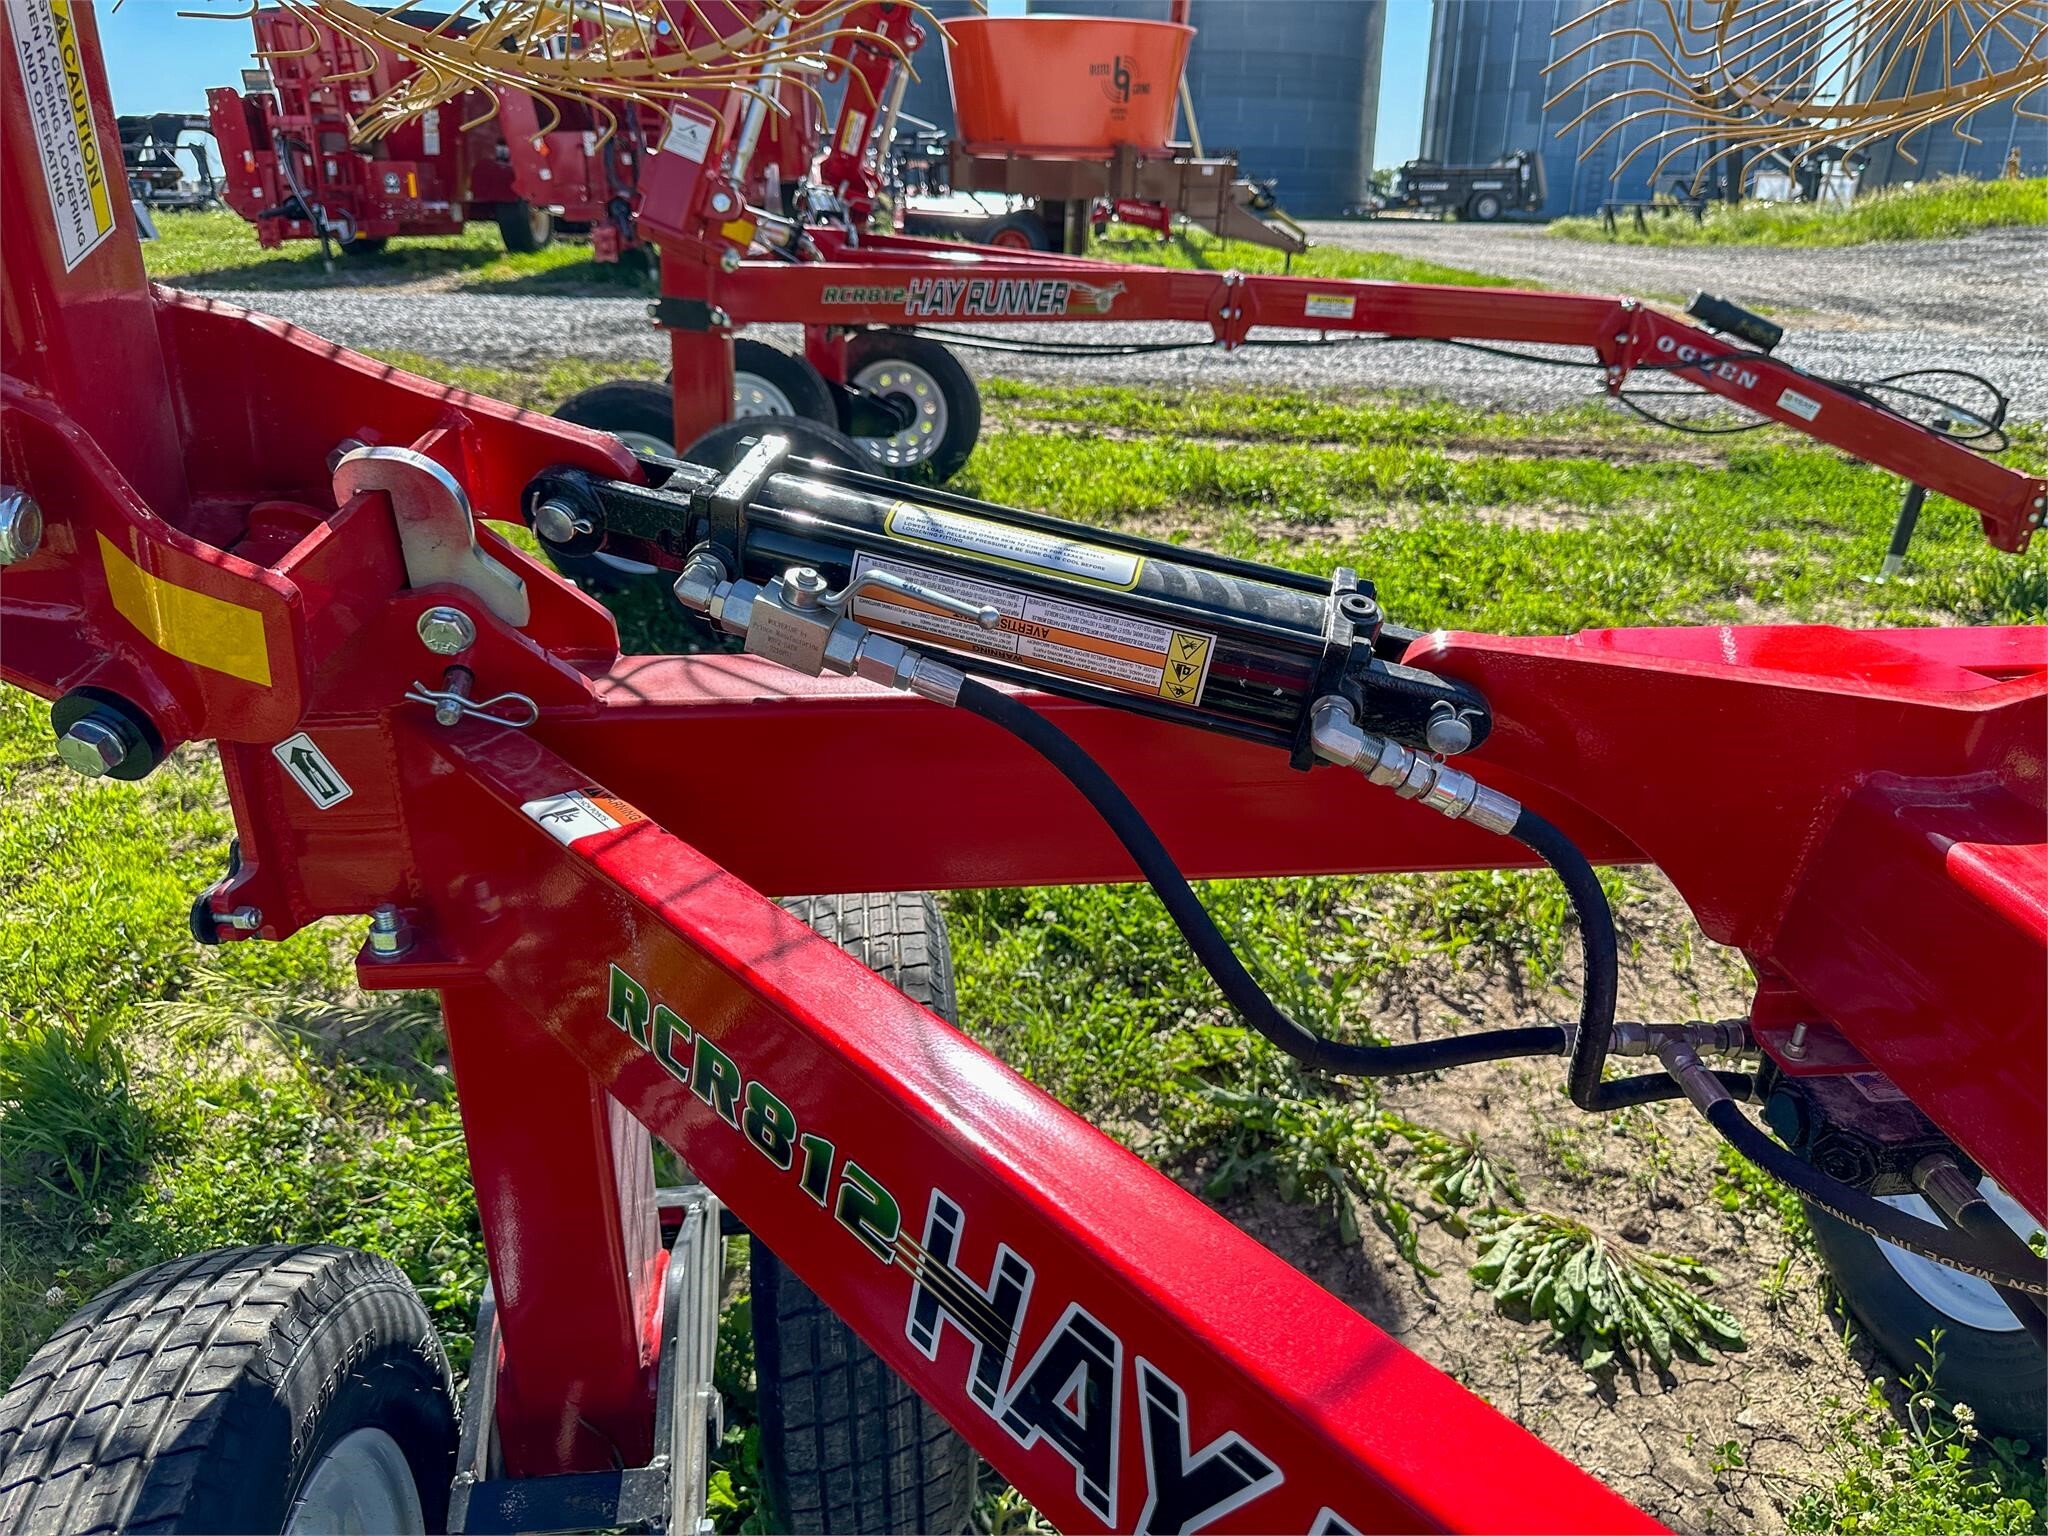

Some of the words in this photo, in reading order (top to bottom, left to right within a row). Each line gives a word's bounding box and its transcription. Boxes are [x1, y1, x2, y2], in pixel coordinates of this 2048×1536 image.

[36, 0, 56, 48] STAY
[49, 55, 72, 125] CLEAR
[20, 39, 39, 85] AND
[32, 90, 67, 207] OPERATING
[60, 43, 101, 188] CAUTION
[36, 47, 64, 138] RAISING,
[57, 143, 88, 247] LOWERING
[65, 129, 79, 159] OF
[71, 161, 91, 213] CART
[822, 286, 906, 304] RCR812
[905, 278, 967, 315] HAY
[963, 280, 1071, 315] RUNNER
[971, 644, 1023, 661] WARNING
[601, 790, 642, 823] WARNING
[1817, 1199, 1876, 1236] CHINA
[607, 963, 903, 1264] RCR812
[906, 1187, 1285, 1536] HAY
[1888, 1235, 1912, 1251] IN
[1921, 1248, 1995, 1282] MADE
